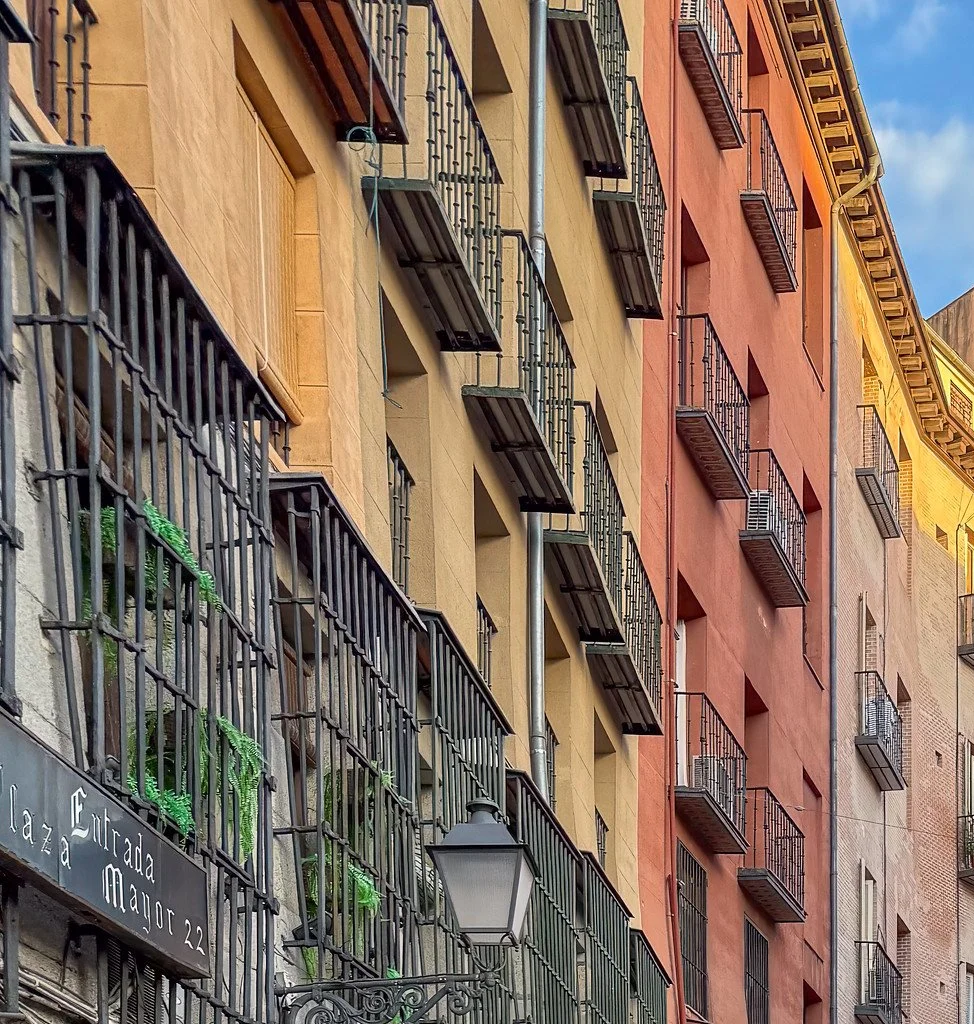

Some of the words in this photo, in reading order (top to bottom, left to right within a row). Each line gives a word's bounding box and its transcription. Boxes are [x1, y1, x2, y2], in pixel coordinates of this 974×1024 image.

[0, 764, 72, 870] laza
[102, 863, 175, 935] Mayor
[184, 919, 206, 956] 22
[71, 786, 155, 884] Entrada
